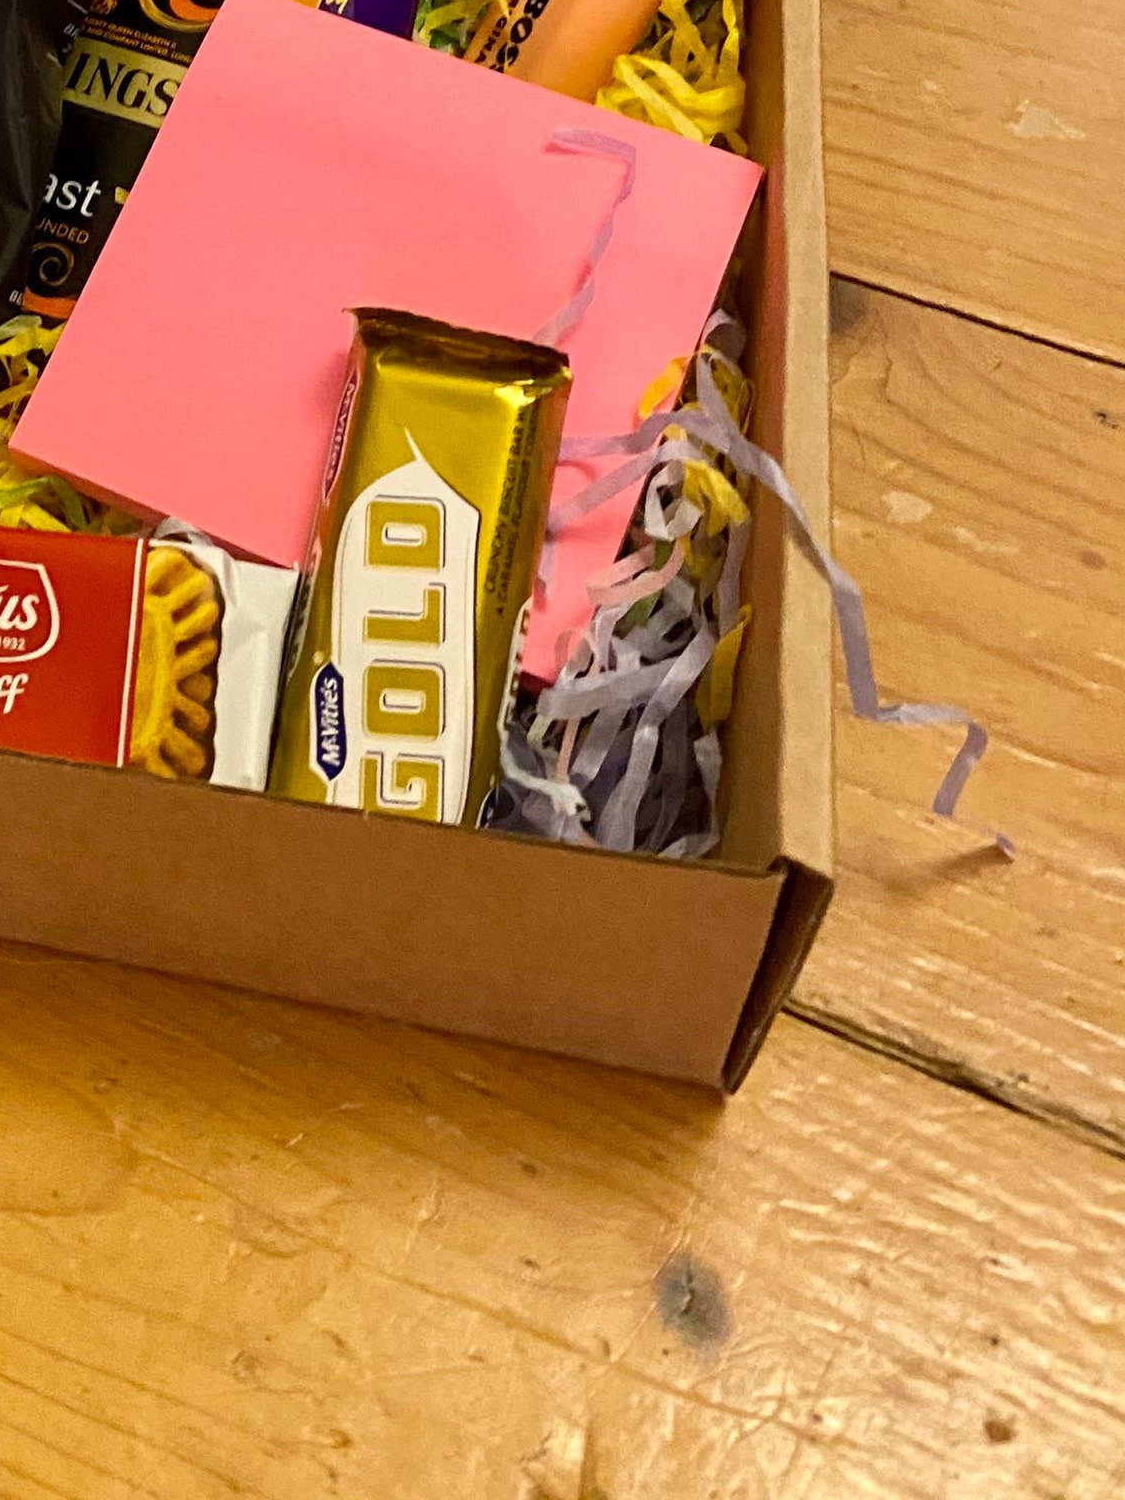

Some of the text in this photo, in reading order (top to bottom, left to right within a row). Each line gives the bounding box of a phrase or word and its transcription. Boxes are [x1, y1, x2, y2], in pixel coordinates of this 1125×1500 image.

[65, 52, 182, 117] INGS
[42, 172, 102, 218] ast
[361, 493, 447, 823] GOLD
